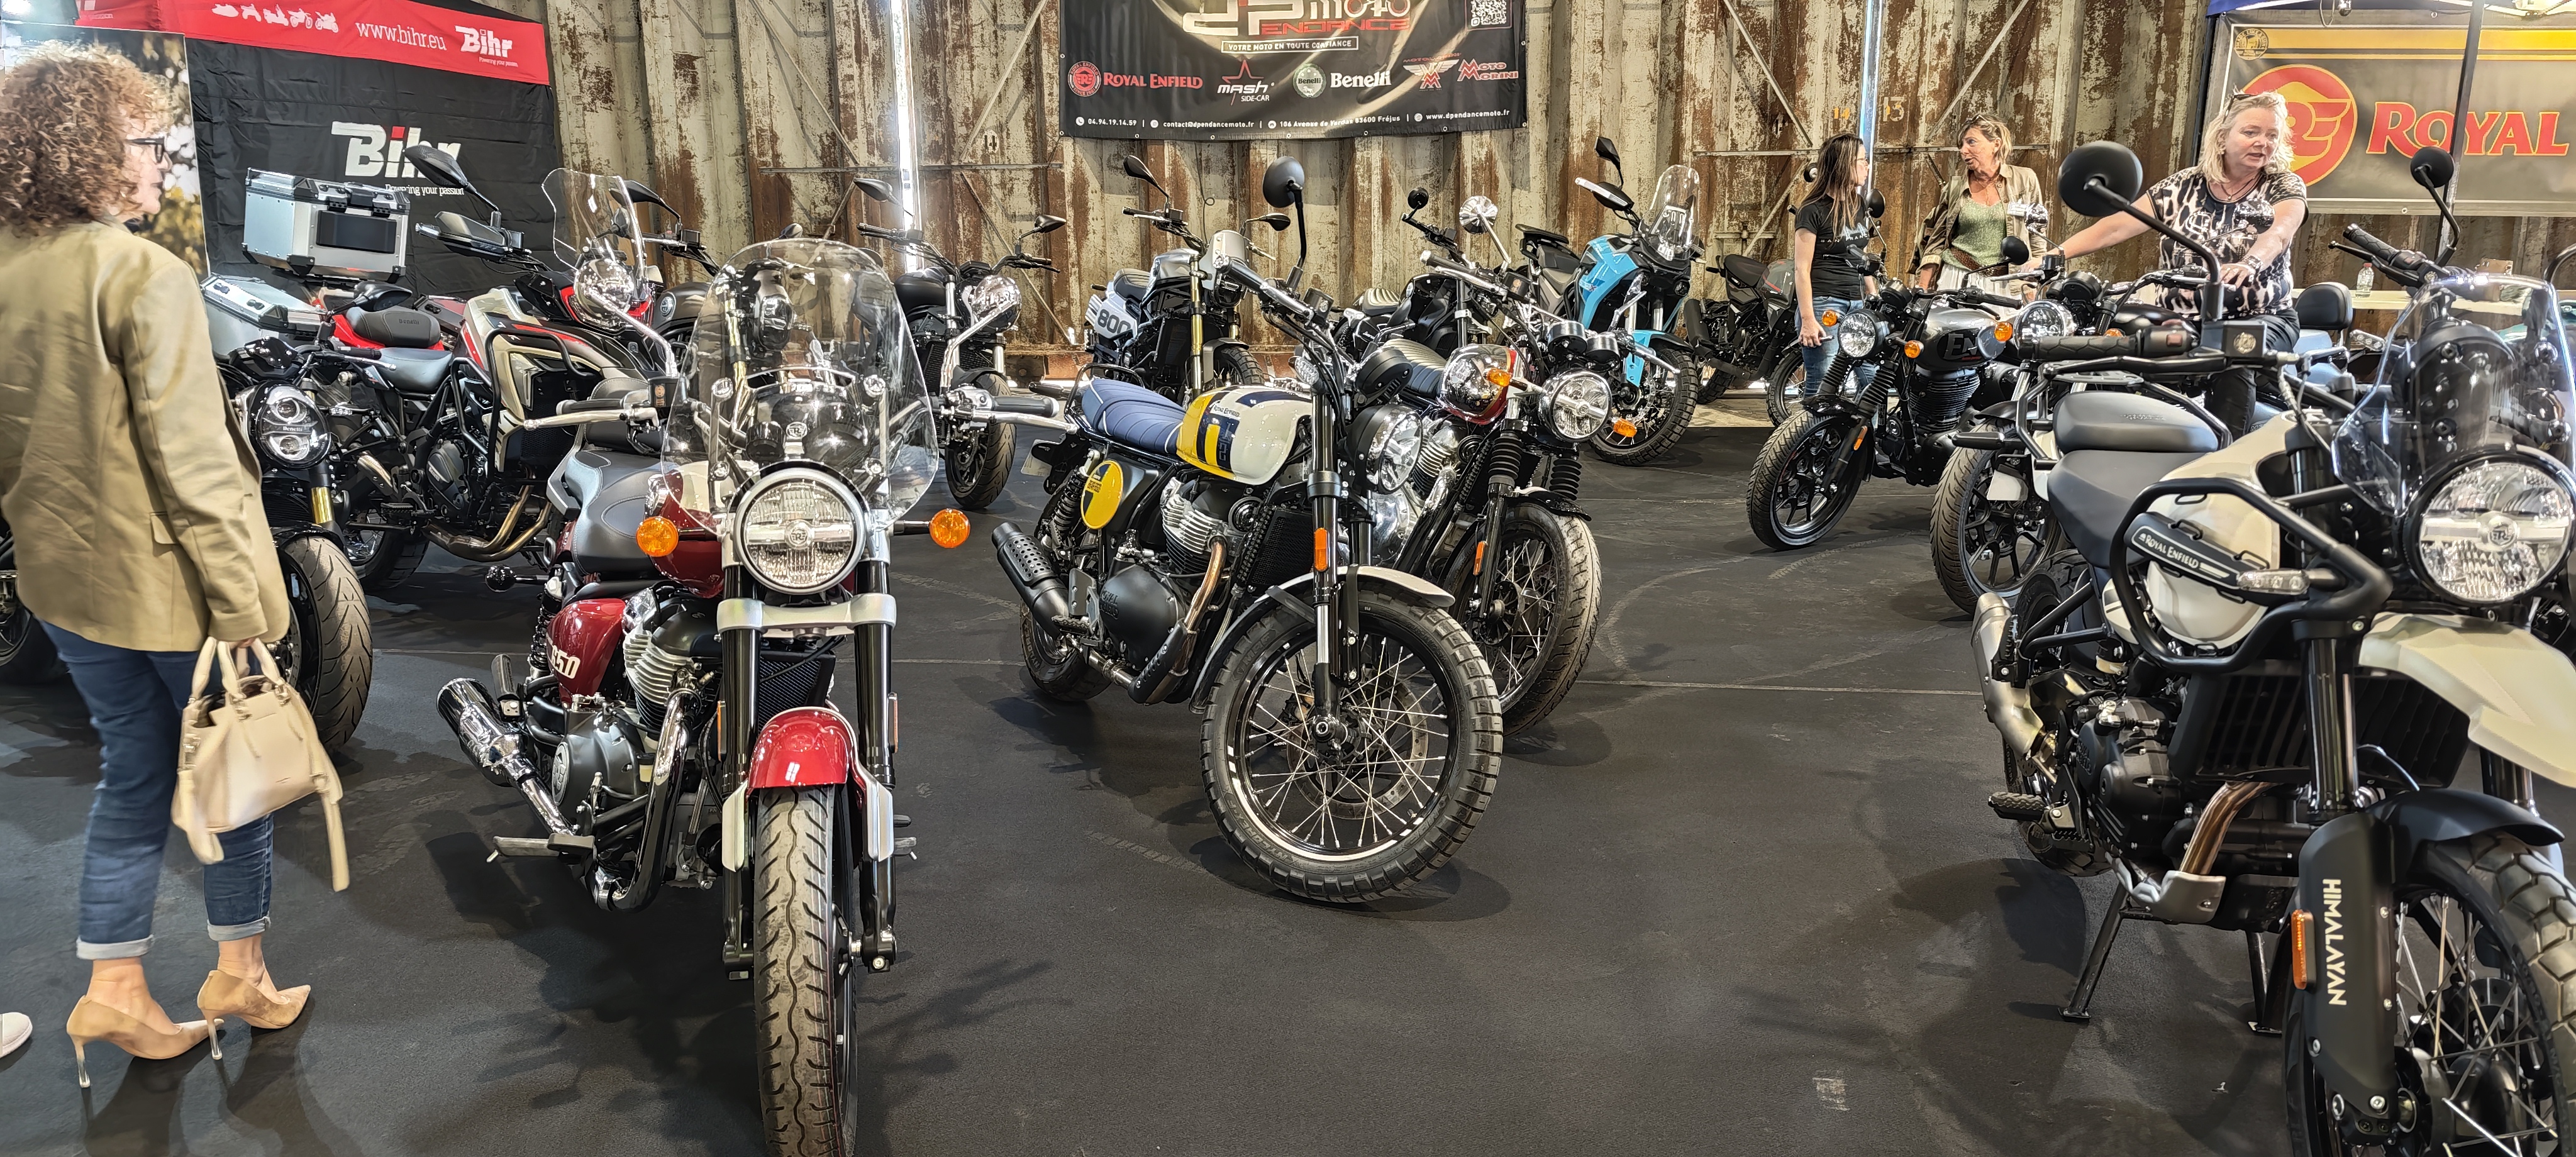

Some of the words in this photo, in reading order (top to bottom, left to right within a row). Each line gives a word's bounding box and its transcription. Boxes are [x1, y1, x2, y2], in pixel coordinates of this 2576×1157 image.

[355, 23, 447, 51] www.bihr.eu
[455, 25, 513, 58] Bihr
[1311, 40, 1352, 48] CONFIANCE
[1103, 72, 1147, 87] ROYAL
[1150, 73, 1203, 89] ENFIELD
[1330, 70, 1392, 88] Benelli
[1377, 114, 1401, 124] Fréjus
[1426, 109, 1510, 121] www.dpendancemoto.fr
[1833, 107, 1850, 119] 14
[2366, 101, 2570, 159] ROYAL
[421, 186, 438, 196] your
[438, 187, 465, 197] passion
[1097, 309, 1131, 335] 800
[2145, 534, 2167, 554] ROYAL
[2167, 546, 2199, 569] ENFIELD
[551, 645, 581, 679] 650
[2322, 878, 2347, 1005] HIMALAYAN
